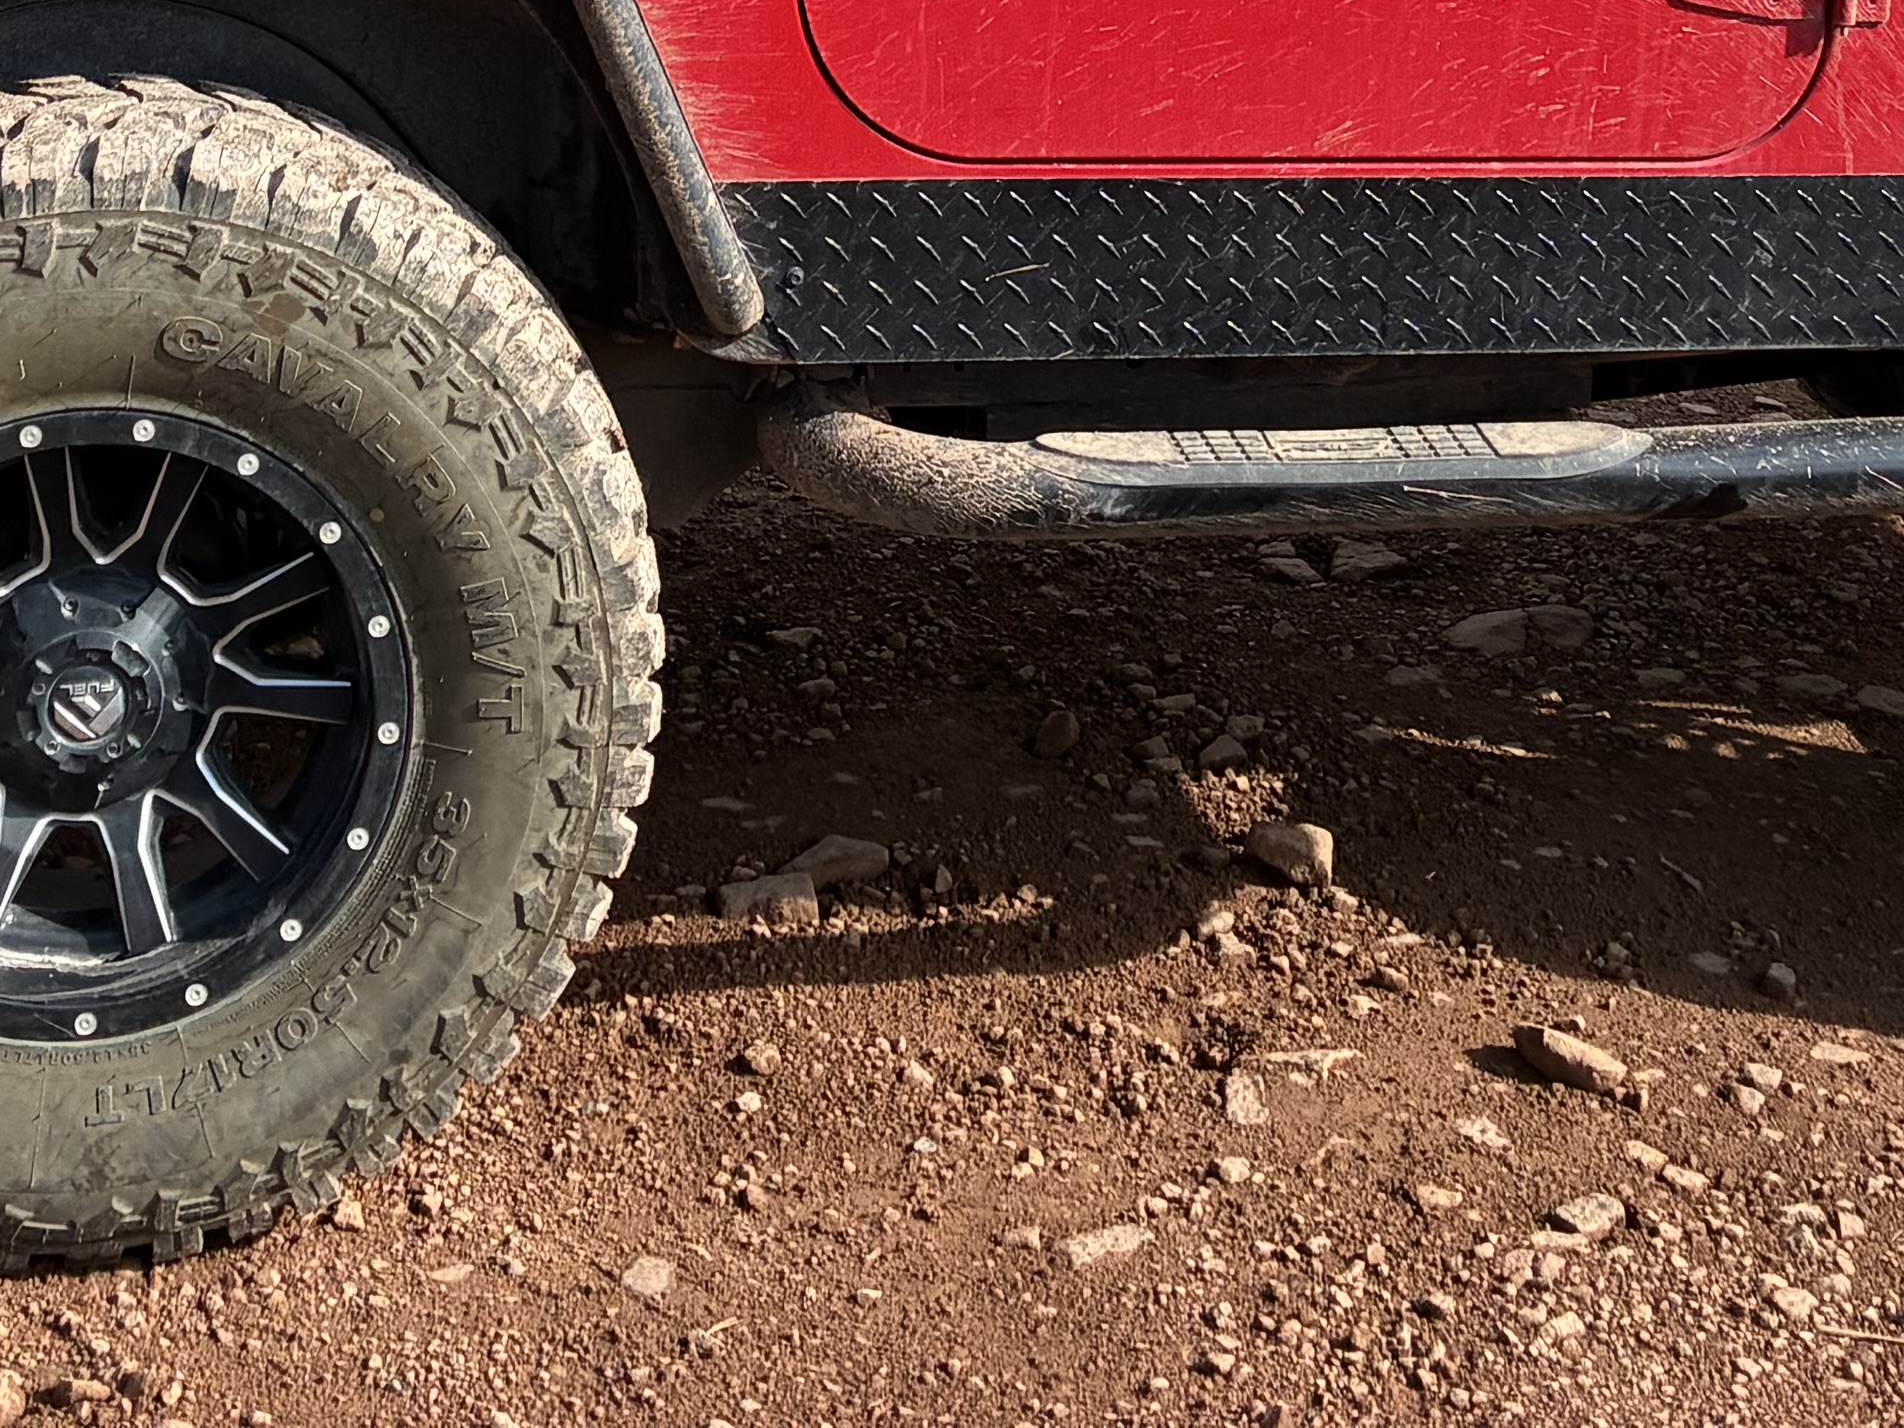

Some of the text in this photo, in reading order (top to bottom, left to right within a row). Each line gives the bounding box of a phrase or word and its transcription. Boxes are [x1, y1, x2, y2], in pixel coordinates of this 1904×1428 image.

[59, 678, 115, 701] FUEL
[156, 316, 491, 550] CAVALRY
[459, 576, 526, 735] M/T
[84, 790, 471, 1127] 35x12.50R17LT
